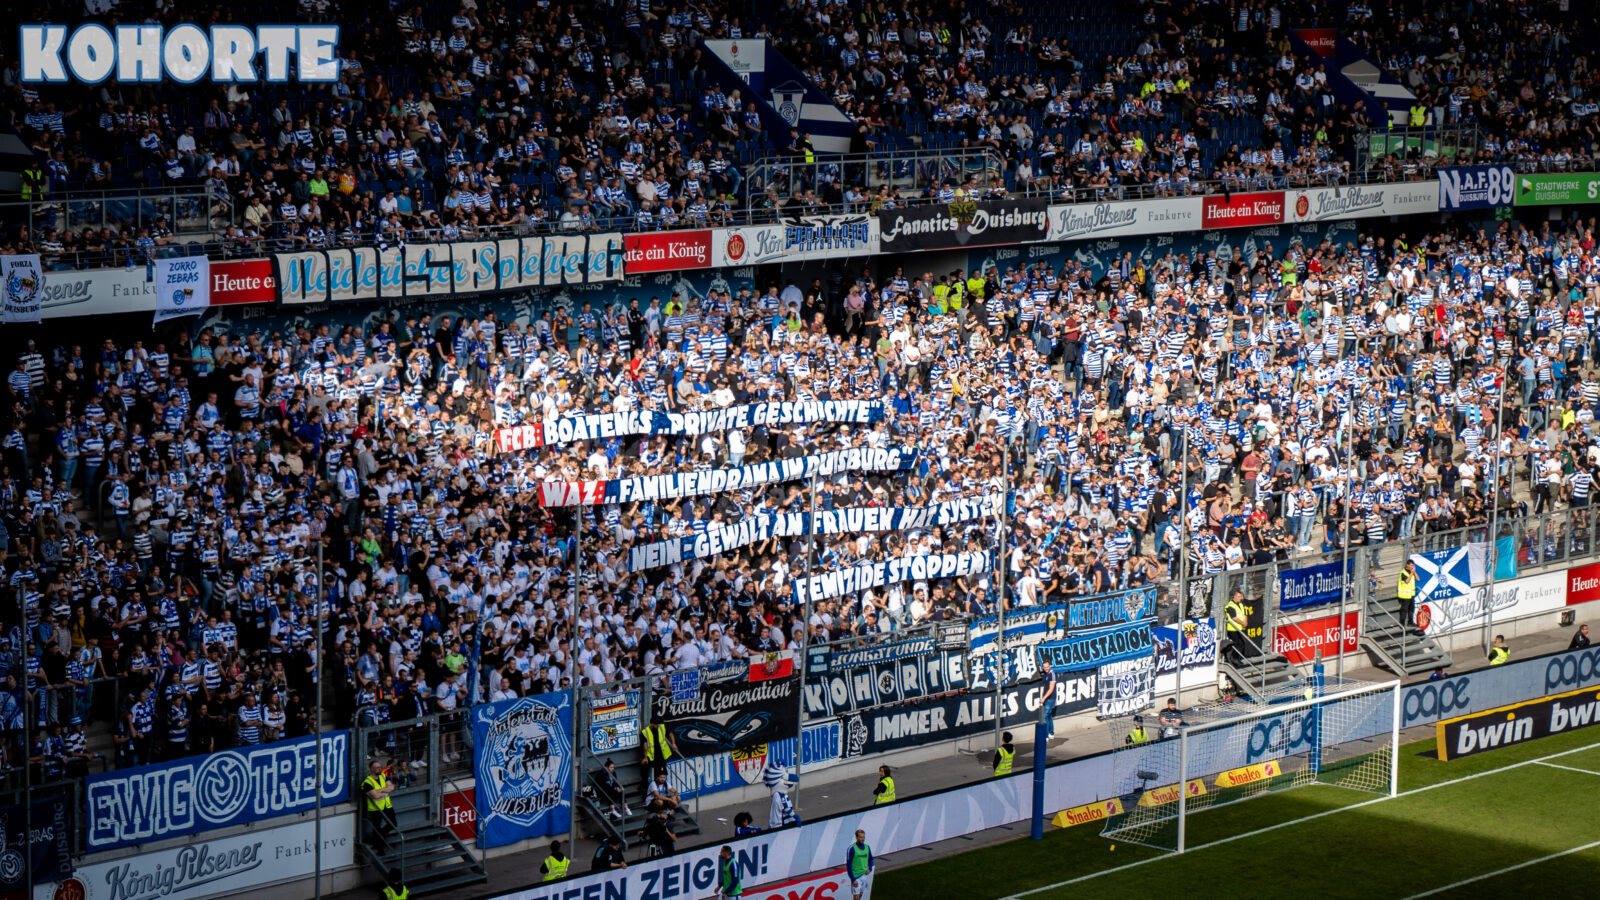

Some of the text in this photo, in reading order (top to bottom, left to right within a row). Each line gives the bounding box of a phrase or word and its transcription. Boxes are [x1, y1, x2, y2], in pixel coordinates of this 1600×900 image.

[1535, 191, 1570, 201] DUISBURG
[1536, 181, 1579, 191] STADTWERKE
[1148, 210, 1192, 222] Fankurve
[1207, 201, 1281, 220] Heute ein König
[881, 208, 1047, 243] Fanatics Duisburg
[646, 244, 665, 259] ein
[668, 241, 706, 264] König
[10, 261, 32, 269] FORZA
[169, 261, 197, 272] ZORRO
[167, 272, 199, 284] ZEBRAS
[213, 274, 276, 292] Heute ei
[499, 424, 542, 452] FCB:
[543, 410, 653, 445] BOATENGS
[541, 481, 604, 507] WAZ:
[782, 457, 804, 478] IN
[632, 539, 681, 572] NEIN
[695, 515, 770, 559] GEWALT
[772, 512, 803, 537] AN
[813, 507, 895, 535] FRAUEN
[898, 504, 937, 529] HAT
[1433, 550, 1449, 560] MSV
[796, 549, 990, 604] FEMIZIDE STOPPEN!
[1571, 576, 1598, 593] Heute
[1434, 588, 1452, 599] PTFC
[1525, 586, 1562, 601] Fankurve
[1069, 596, 1126, 628] METROPOL
[1037, 625, 1152, 667] WEDAUSTADION
[1275, 624, 1357, 654] Heute ein König
[804, 654, 965, 712] KOHORTE
[657, 680, 792, 717] Proud Generation
[874, 674, 1097, 742] IMMER ALLES GBEN!
[1402, 677, 1471, 728] pape
[1457, 712, 1534, 755] bwin
[666, 723, 839, 794] UHRPOTT DUIBURG
[1228, 769, 1261, 786] Sinalco
[88, 734, 346, 847] EWIG TREU
[1151, 788, 1181, 805] Sinalc
[1066, 807, 1103, 826] Sinalco
[53, 801, 72, 873] DUISBURG
[275, 836, 347, 860] Fankrve
